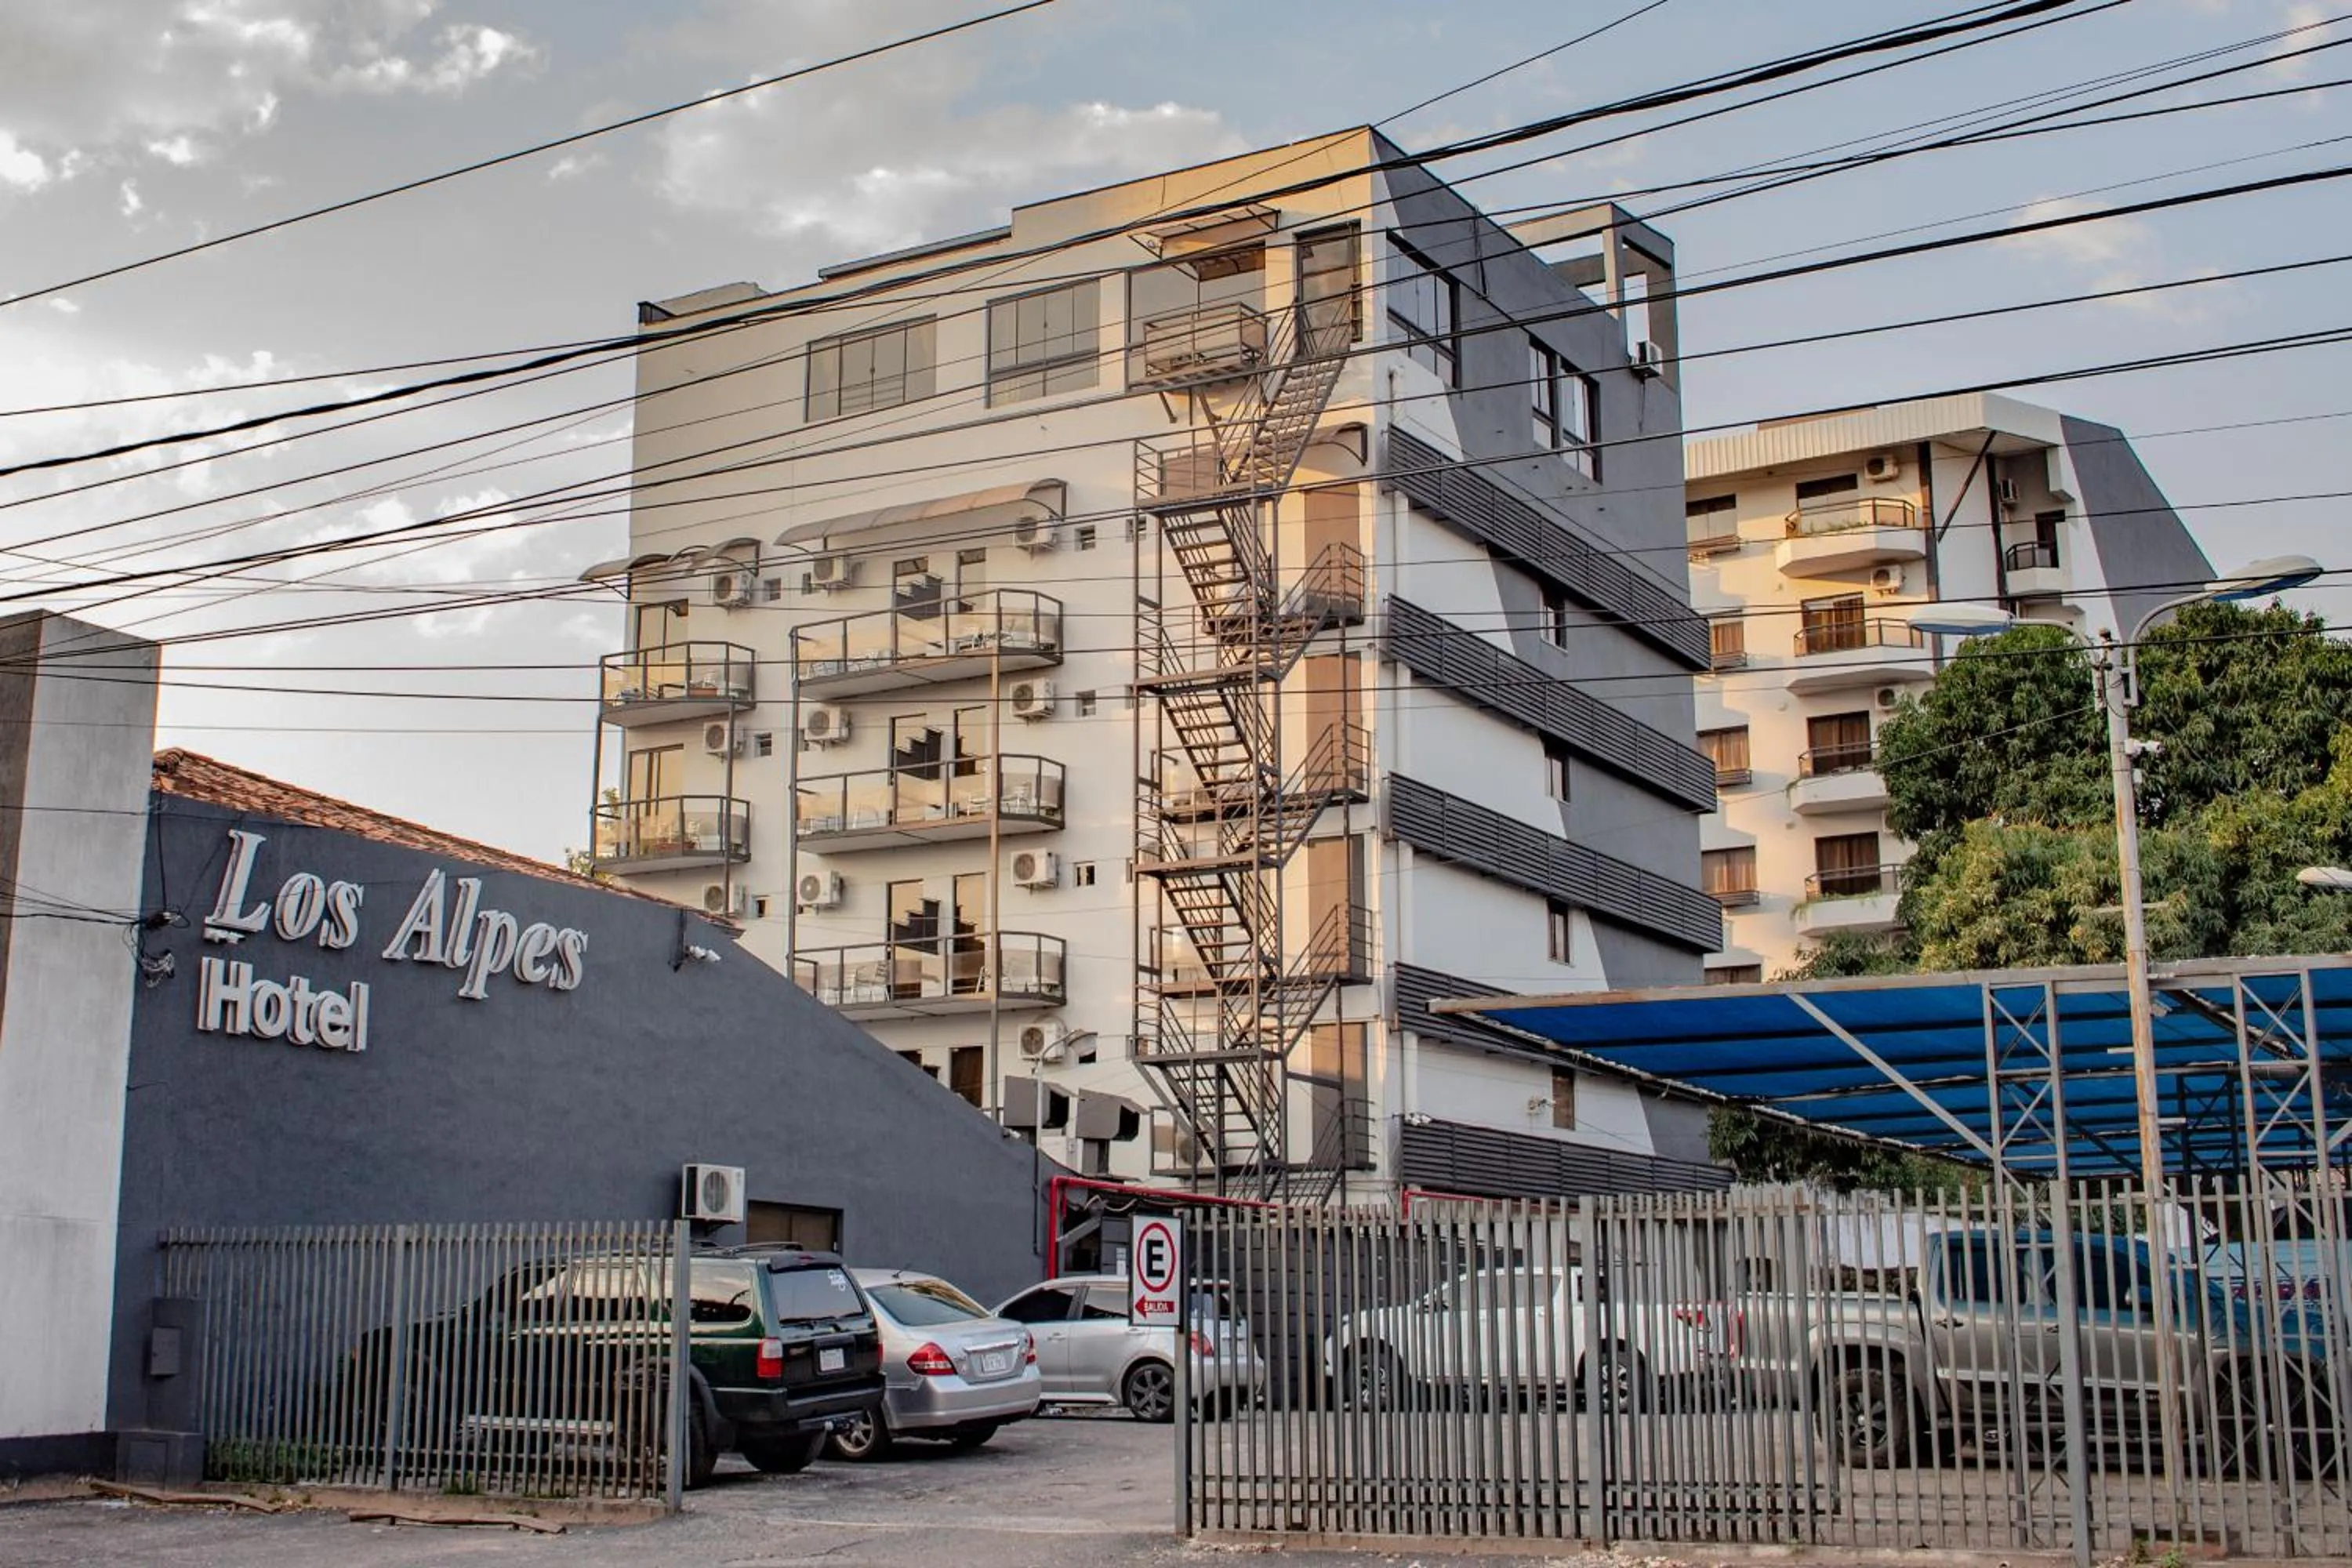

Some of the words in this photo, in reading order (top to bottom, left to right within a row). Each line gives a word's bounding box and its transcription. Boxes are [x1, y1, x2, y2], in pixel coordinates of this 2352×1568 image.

[203, 828, 364, 949] Los
[382, 867, 589, 1000] Alpes
[198, 956, 370, 1052] Hotel
[1146, 1240, 1165, 1277] E
